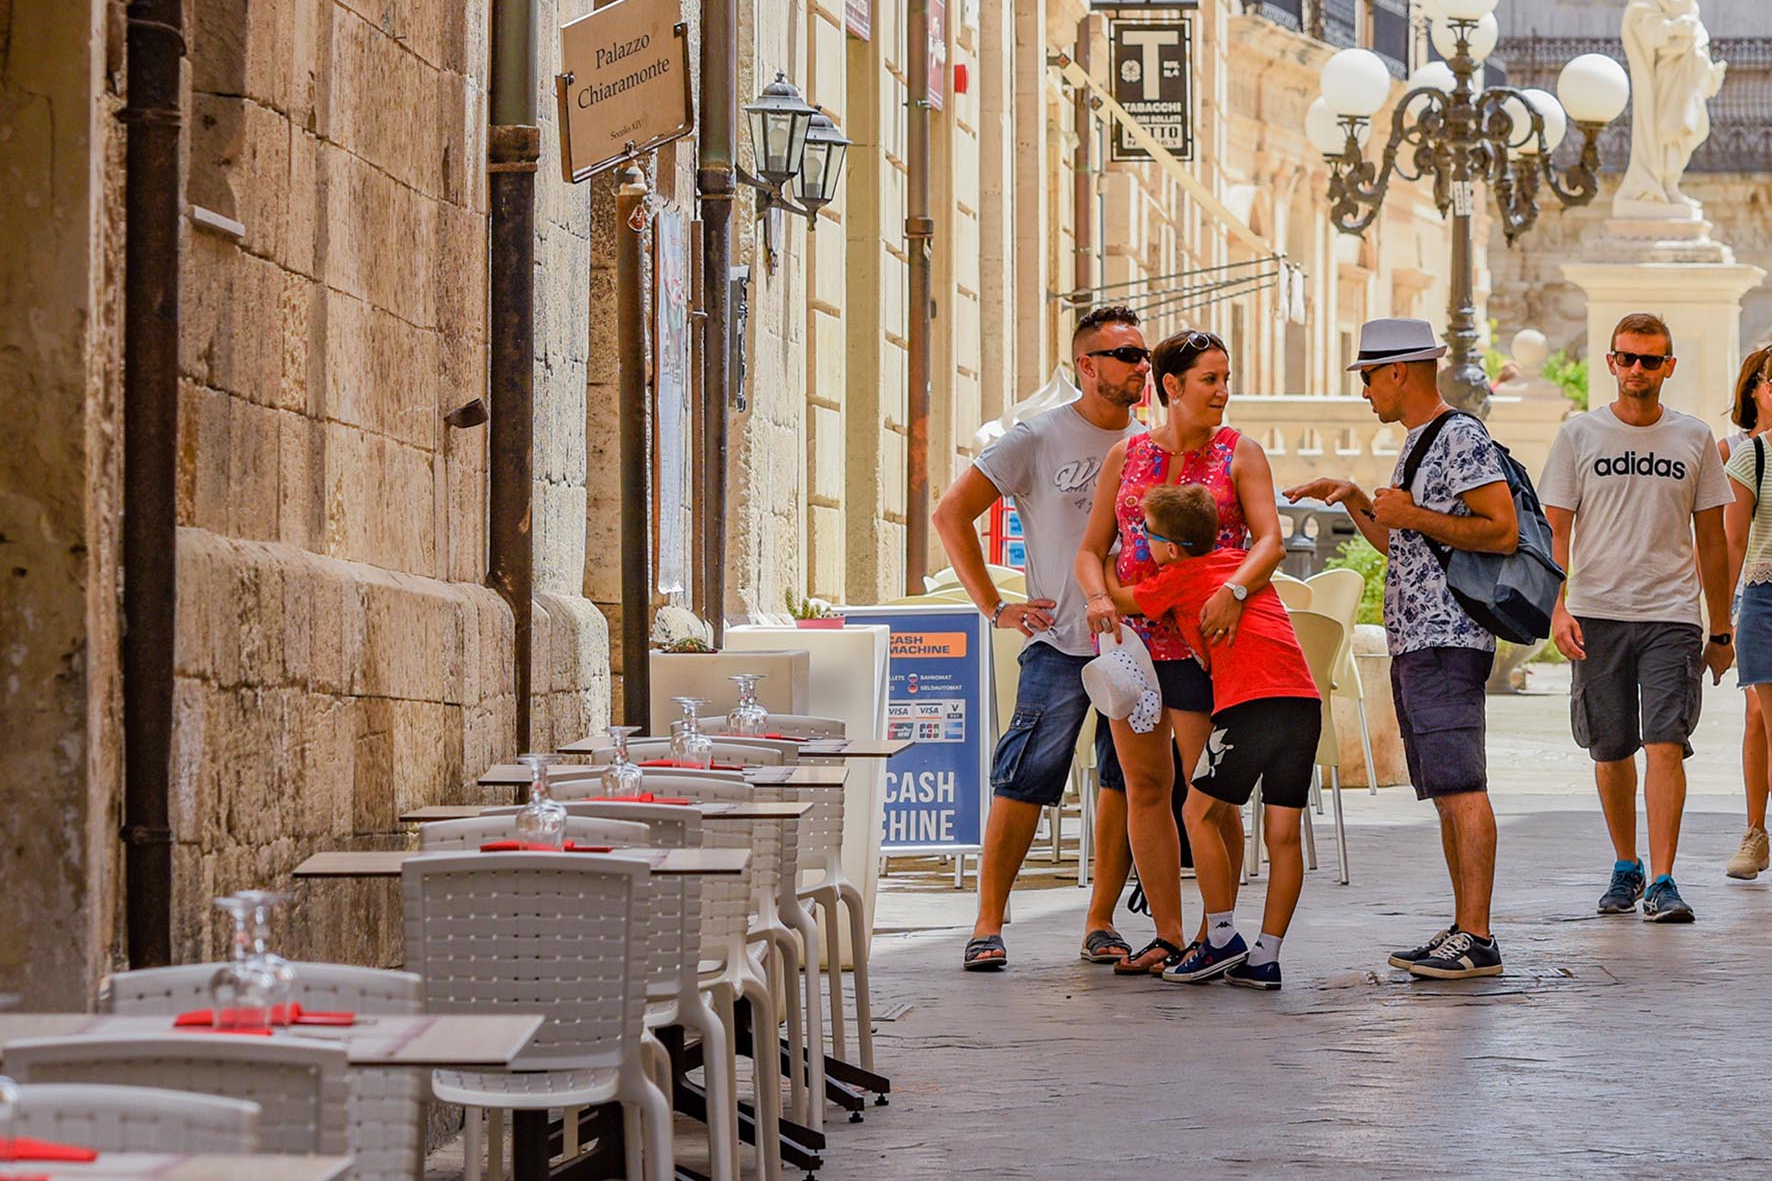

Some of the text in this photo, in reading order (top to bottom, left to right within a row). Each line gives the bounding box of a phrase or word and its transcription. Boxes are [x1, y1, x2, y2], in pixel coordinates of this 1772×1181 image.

[595, 33, 650, 70] Palazzo
[1122, 30, 1179, 100] T
[578, 58, 670, 109] Chiaramonte
[1122, 102, 1181, 113] TABACCHI
[1127, 126, 1178, 139] LTTO
[1593, 450, 1686, 480] adidas
[889, 645, 950, 654] MACHINE
[885, 771, 954, 803] CASH
